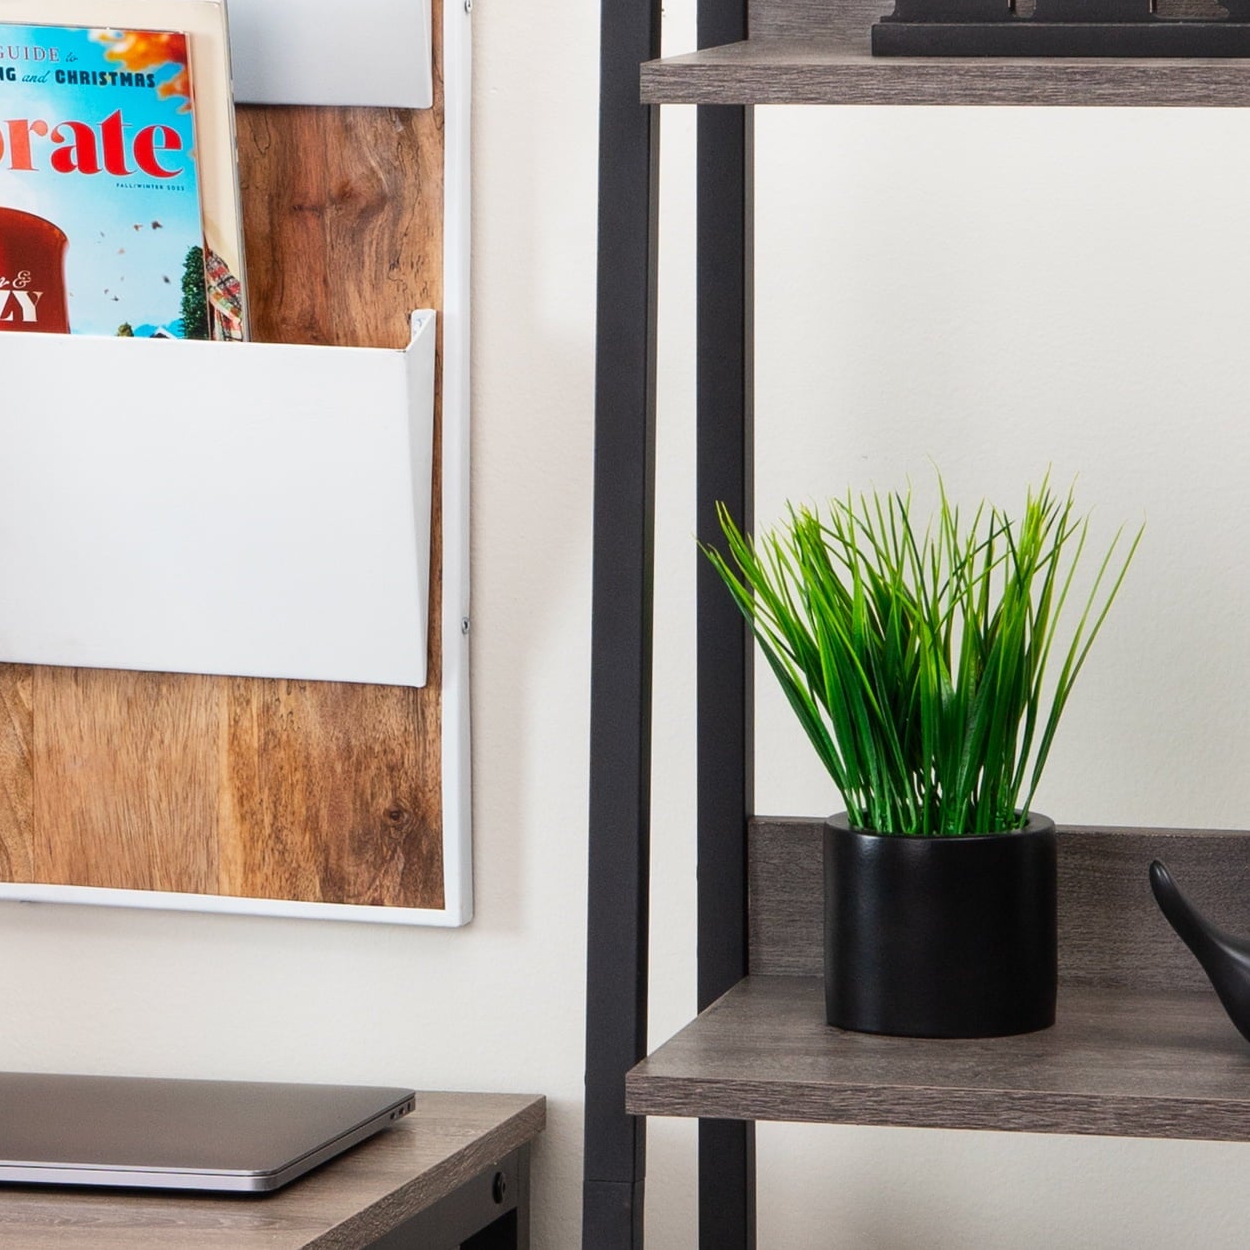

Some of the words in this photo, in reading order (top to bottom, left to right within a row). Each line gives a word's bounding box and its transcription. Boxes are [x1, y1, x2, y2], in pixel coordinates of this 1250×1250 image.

[65, 51, 79, 62] to
[21, 70, 52, 84] and
[55, 69, 156, 88] CHRISTMAS
[12, 270, 32, 289] &
